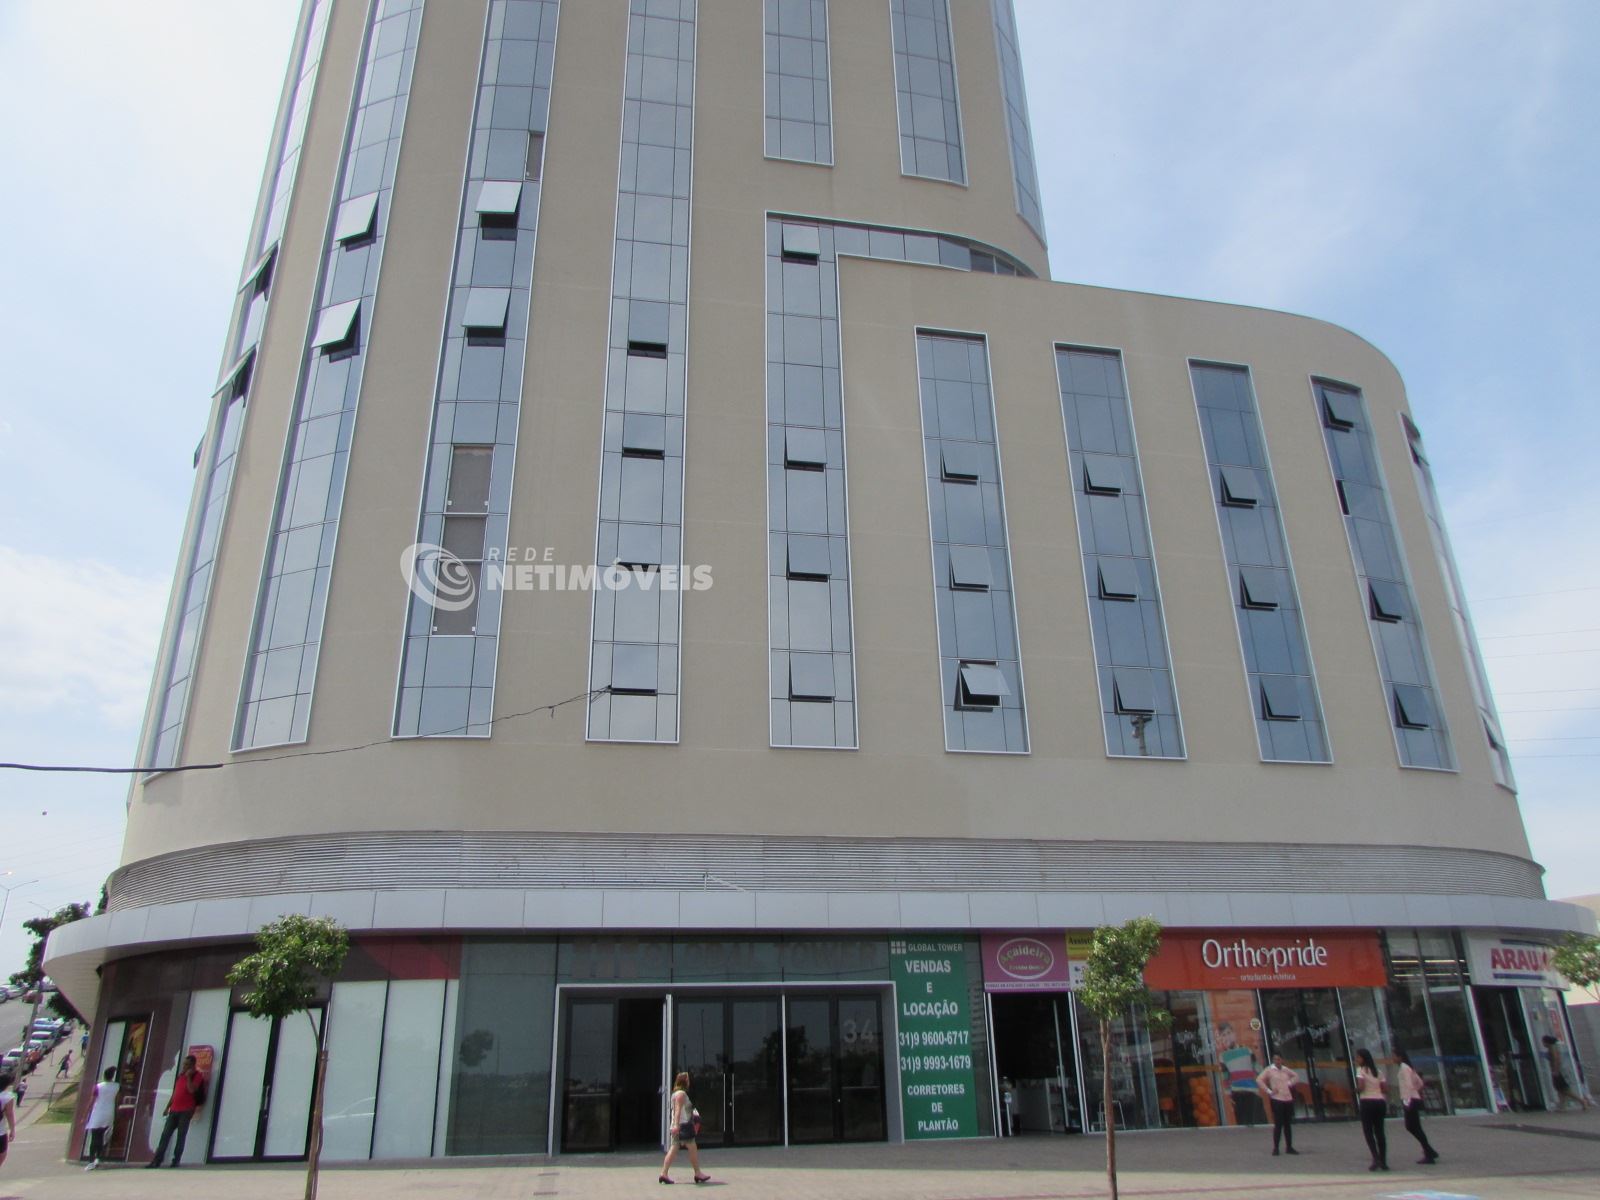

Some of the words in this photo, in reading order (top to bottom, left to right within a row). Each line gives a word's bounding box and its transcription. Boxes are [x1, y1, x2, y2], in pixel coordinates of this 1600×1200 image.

[908, 943, 936, 952] GLOBAL
[938, 943, 964, 952] TOWER
[1202, 938, 1328, 974] Orthopride
[1491, 947, 1550, 971] ARAU
[904, 960, 952, 973] VENDAS
[926, 982, 933, 993] E
[903, 999, 959, 1019] LOCAÇÃO
[843, 1018, 874, 1043] 34
[921, 1030, 969, 1045] 9600-6717
[923, 1055, 971, 1070] 9993-1679
[907, 1083, 965, 1096] CORRETORES
[931, 1102, 943, 1113] DE
[918, 1117, 959, 1132] PLANTÃO
